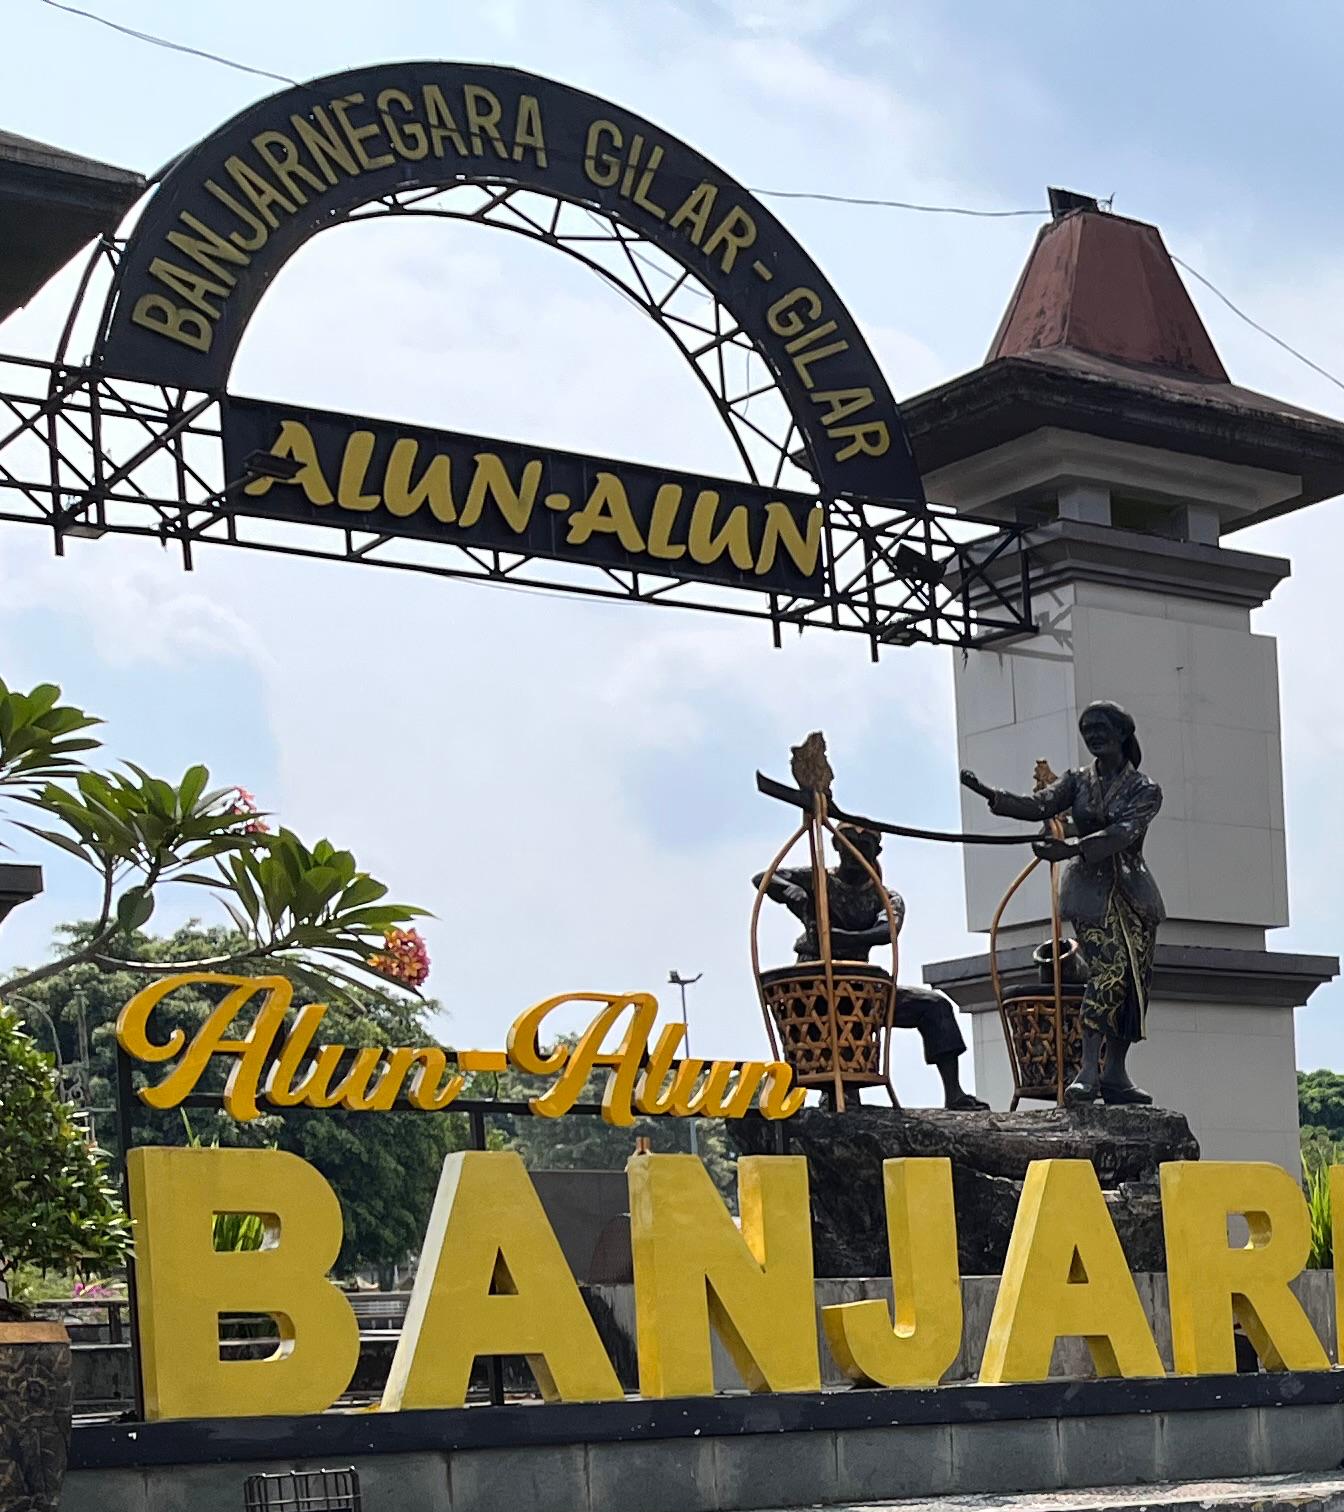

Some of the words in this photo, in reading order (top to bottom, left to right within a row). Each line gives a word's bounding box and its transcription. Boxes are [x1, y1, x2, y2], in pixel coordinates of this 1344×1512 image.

[132, 85, 549, 354] BANJARNEGARA
[245, 420, 823, 577] ALUN-ALUN
[116, 972, 807, 1127] Alun-Alun
